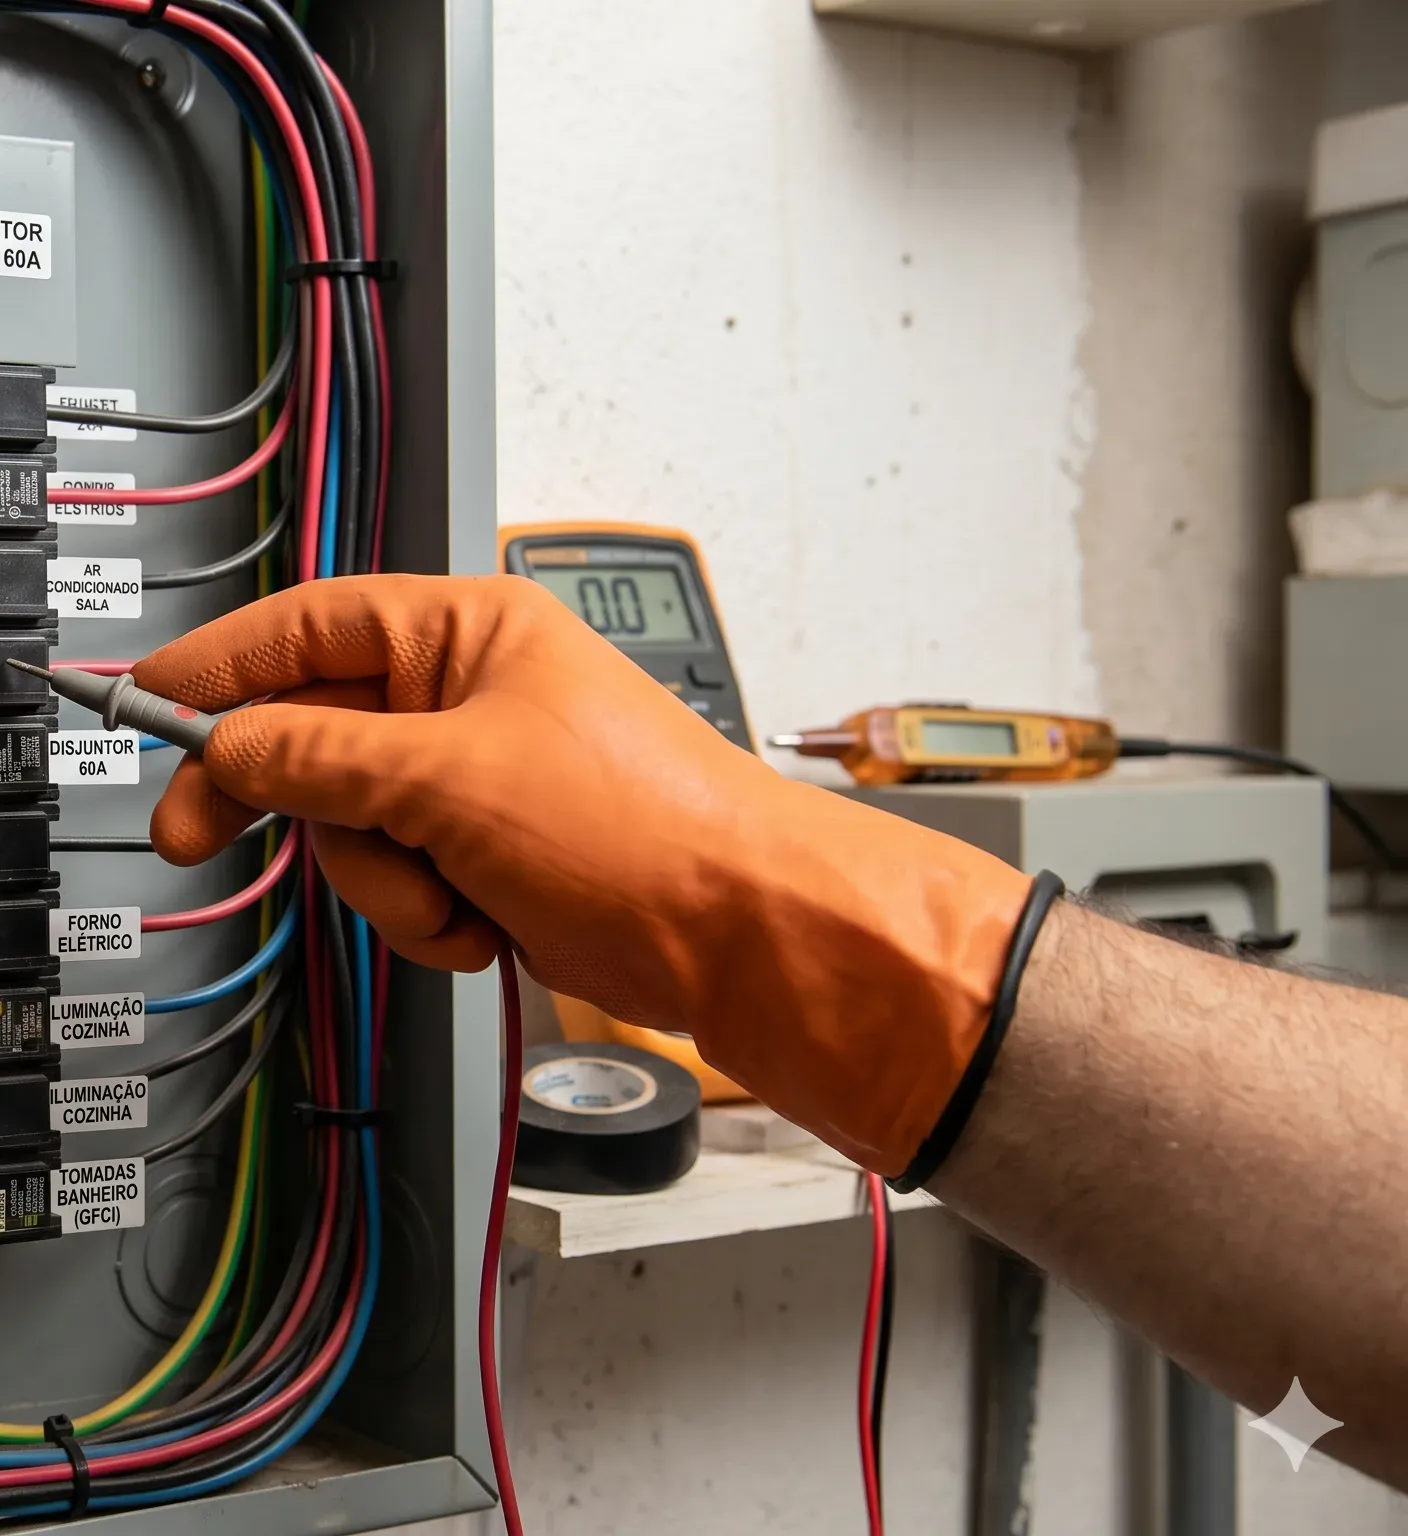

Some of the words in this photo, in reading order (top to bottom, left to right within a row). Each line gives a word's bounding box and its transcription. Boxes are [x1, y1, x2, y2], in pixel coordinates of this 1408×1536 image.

[4, 250, 42, 269] 60A
[84, 565, 101, 576] AR
[48, 581, 138, 594] CONDICIONADO
[76, 599, 109, 610] SALA
[50, 740, 133, 755] DISJUNTOR
[80, 761, 107, 775] 60A
[69, 914, 121, 931] FORNO
[59, 933, 132, 952] ELÉTRICO
[52, 997, 143, 1020] LUMINAÇÃO
[62, 1021, 130, 1040] COZINHA
[50, 1080, 146, 1105] ILUMINAÇÃO
[63, 1105, 132, 1124] COZINHA
[59, 1163, 136, 1185] TOMADAS
[58, 1184, 138, 1206] BANHEIRO
[74, 1206, 121, 1229] (GFCI)
